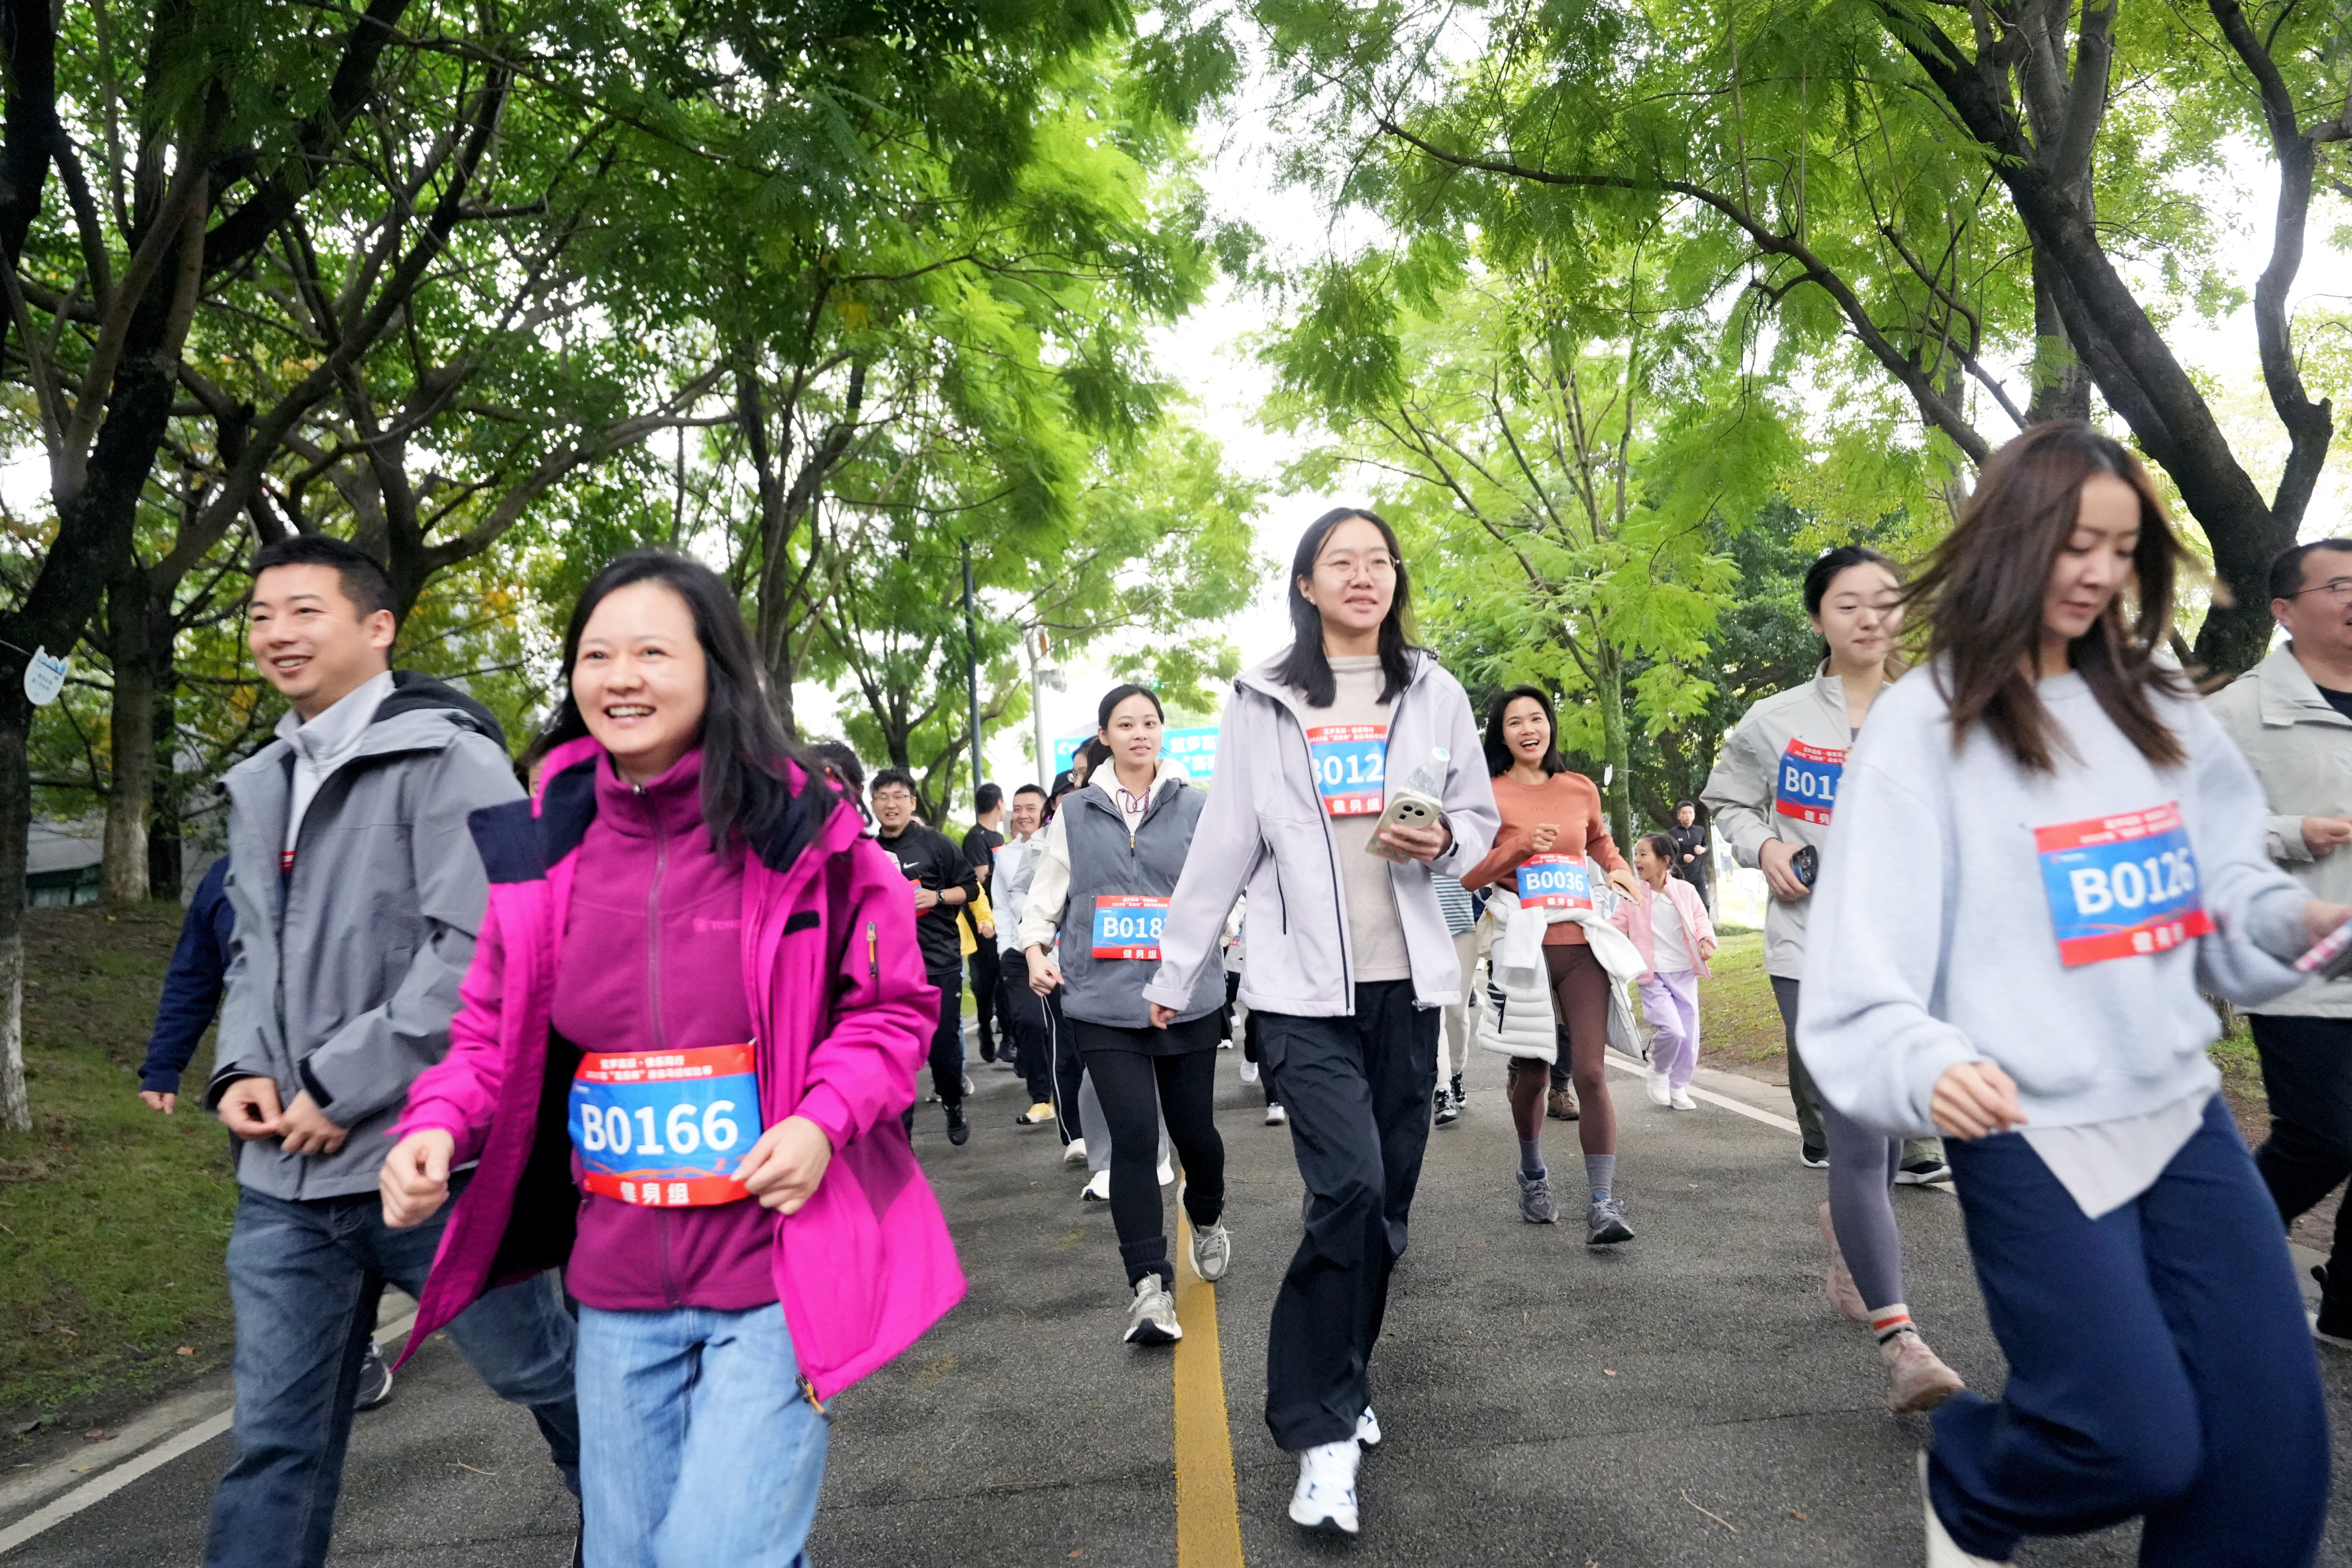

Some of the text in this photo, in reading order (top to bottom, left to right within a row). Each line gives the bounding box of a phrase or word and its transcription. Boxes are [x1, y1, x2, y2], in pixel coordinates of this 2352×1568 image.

[1785, 766, 1838, 800] B01
[1333, 797, 1380, 813] 健身组
[1526, 871, 1584, 892] B0036
[1103, 917, 1166, 938] B018
[1123, 949, 1157, 959] 健身组
[580, 1100, 738, 1155] B0166
